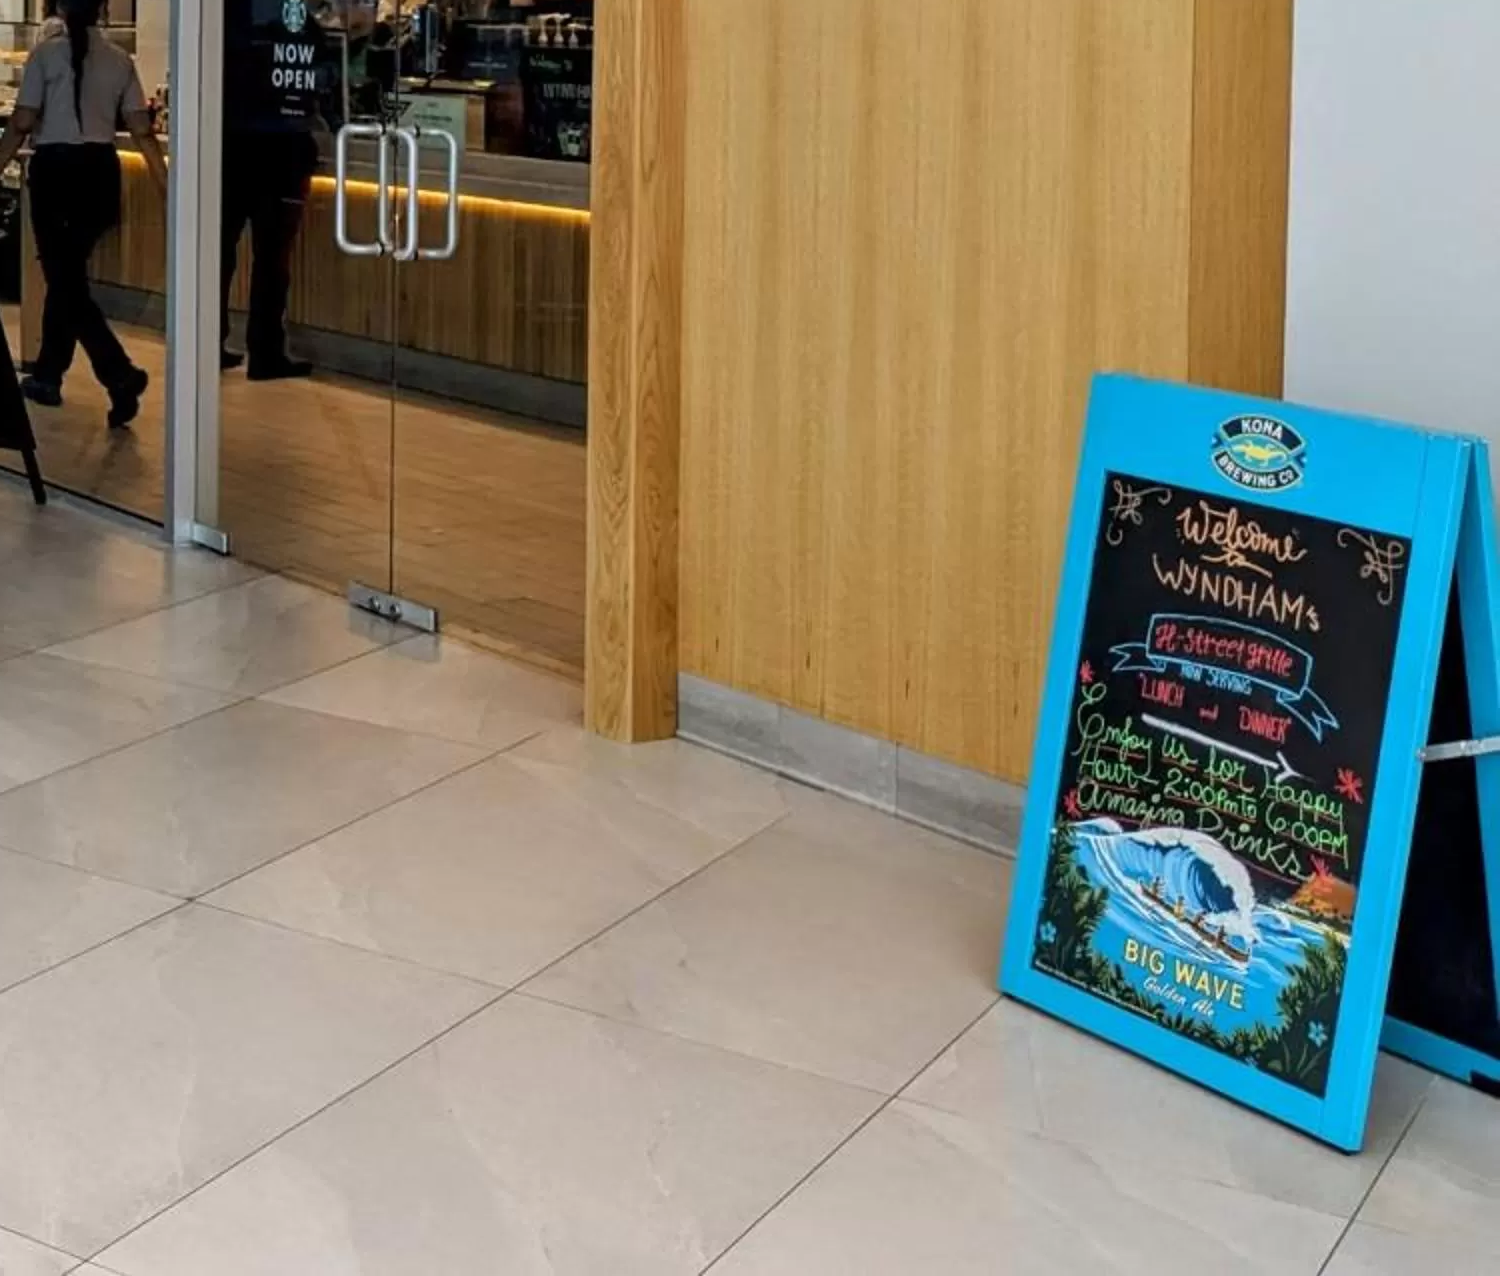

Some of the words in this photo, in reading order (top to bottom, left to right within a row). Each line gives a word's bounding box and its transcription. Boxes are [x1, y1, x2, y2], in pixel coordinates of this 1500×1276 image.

[273, 43, 315, 65] NOW
[271, 70, 316, 91] OPEN
[1241, 419, 1283, 441] KONA
[1218, 455, 1277, 487] BREWING
[1176, 500, 1308, 562] Welcome
[1079, 738, 1150, 788] Hour
[1260, 764, 1344, 830] Happy
[1124, 938, 1165, 975] BIG
[1175, 959, 1245, 1009] WAVE
[1143, 976, 1187, 1005] Golden
[1191, 998, 1215, 1017] Ale
